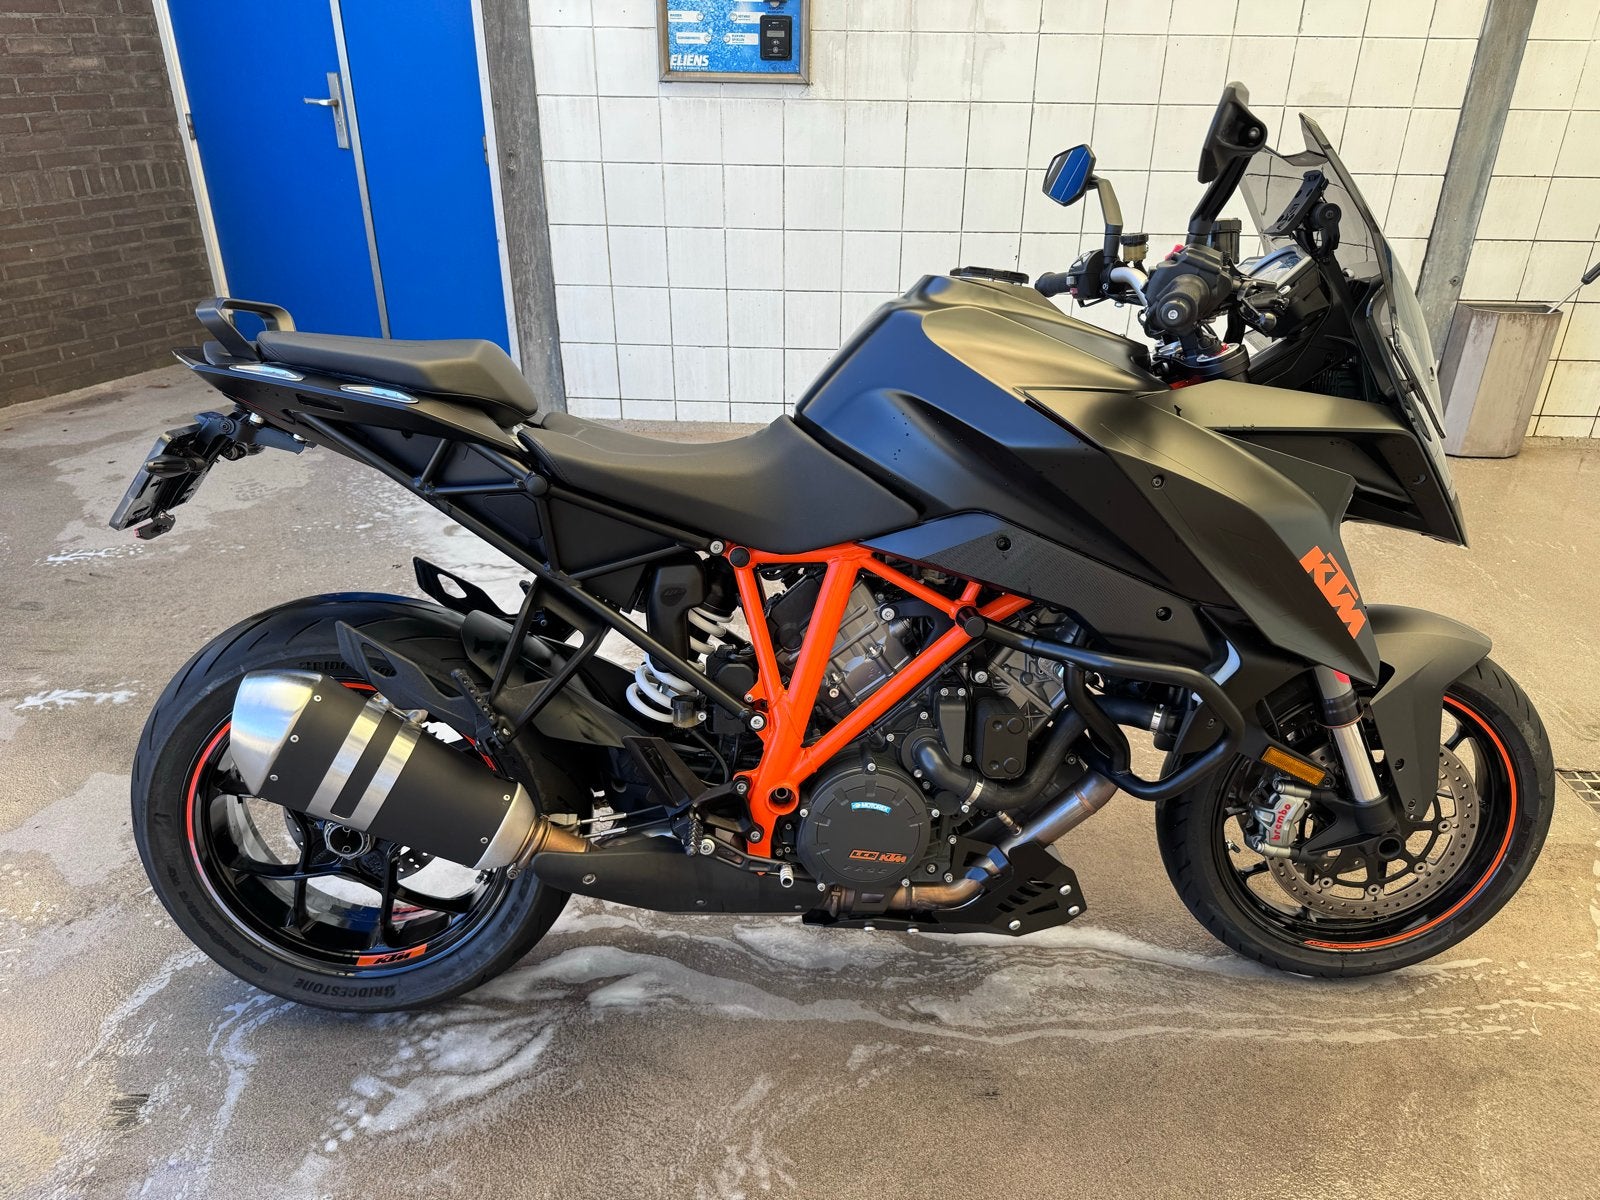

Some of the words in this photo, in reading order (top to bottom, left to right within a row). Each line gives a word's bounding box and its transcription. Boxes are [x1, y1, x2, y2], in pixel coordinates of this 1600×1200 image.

[670, 54, 709, 67] ELIENS
[1299, 545, 1366, 640] KTM
[1271, 803, 1291, 841] brembo
[879, 852, 906, 863] KTM
[373, 951, 412, 965] KTM
[293, 977, 397, 998] BRIDGESTONE
